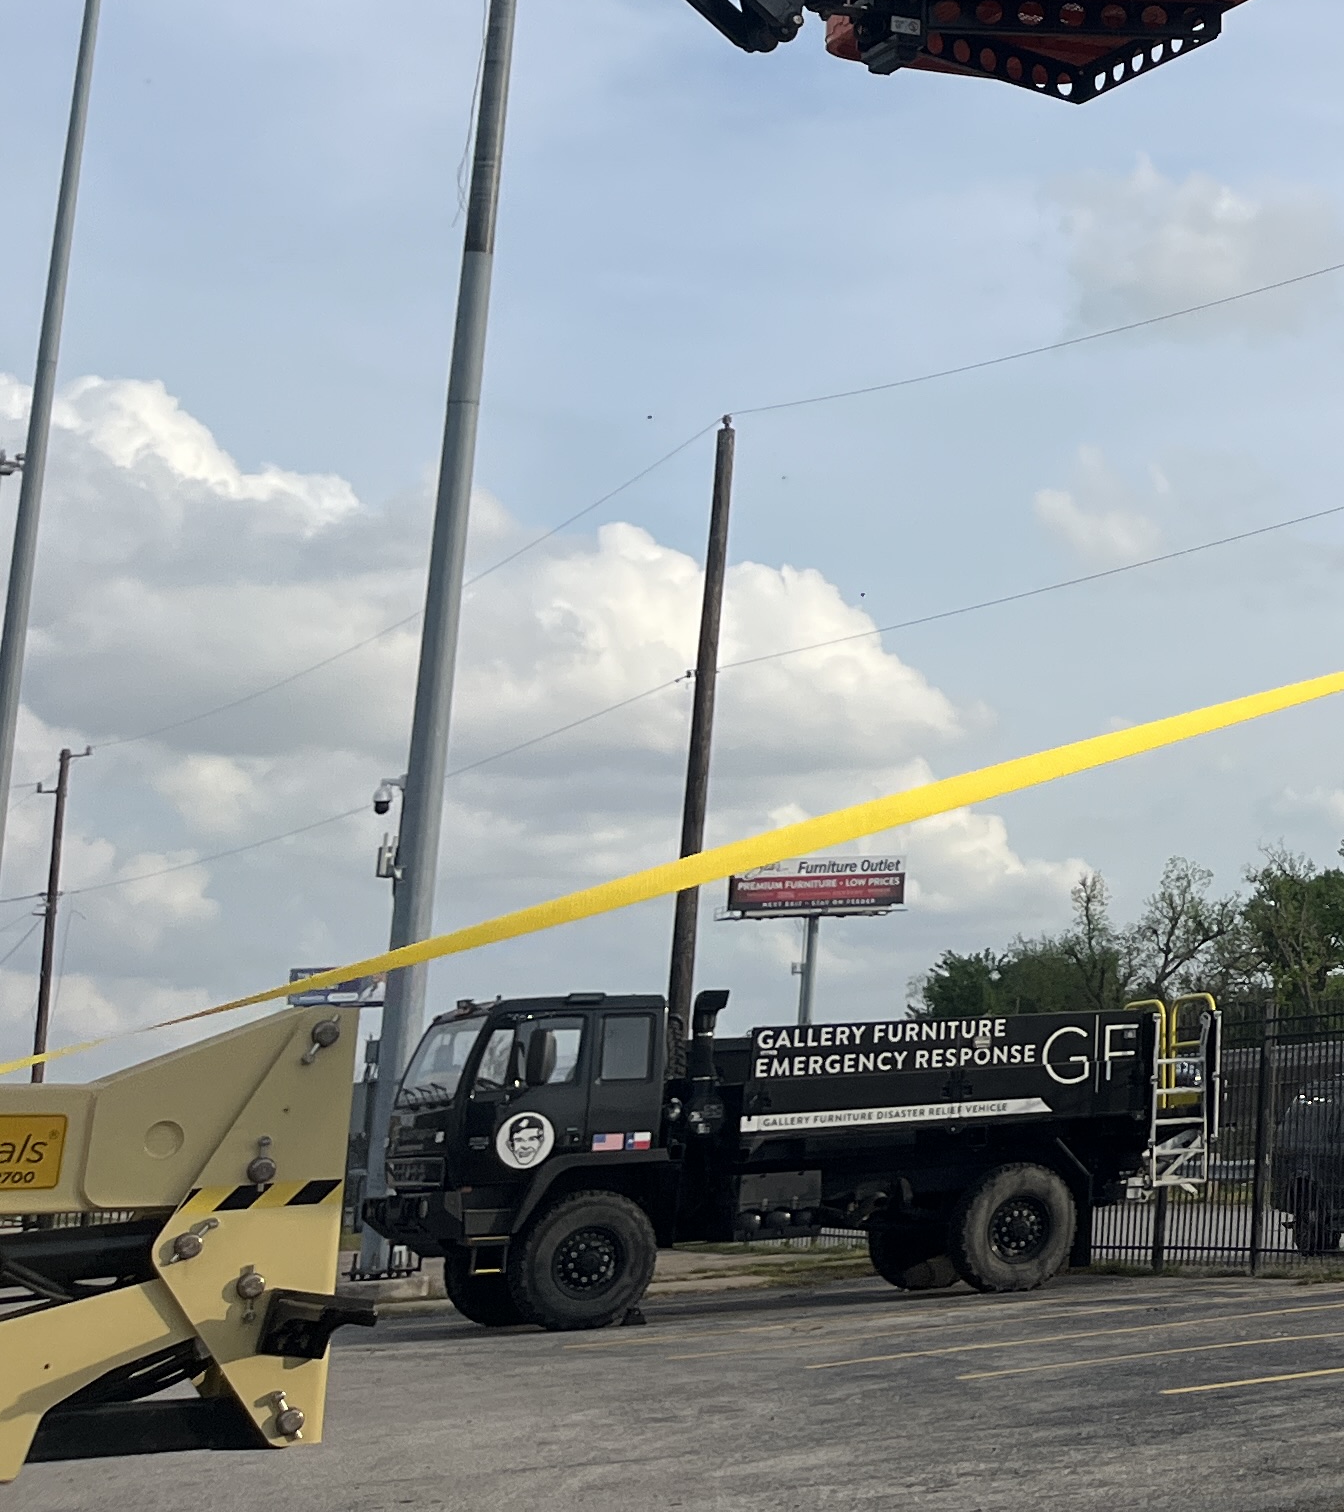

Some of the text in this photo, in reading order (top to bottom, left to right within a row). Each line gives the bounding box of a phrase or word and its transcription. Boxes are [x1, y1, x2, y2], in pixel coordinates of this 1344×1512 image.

[797, 860, 858, 875] Furniture
[860, 859, 901, 873] Outlet
[737, 876, 901, 891] PREMIUM FURNITURE LOW PRICES
[757, 1019, 1007, 1050] GALLERY FURNITURE
[755, 1044, 1036, 1078] EMERGENCY RESPONSE
[762, 1102, 1008, 1127] GALLERY FURNITURE DISASTER RELIEF VEHICLE
[0, 1171, 35, 1184] 700
